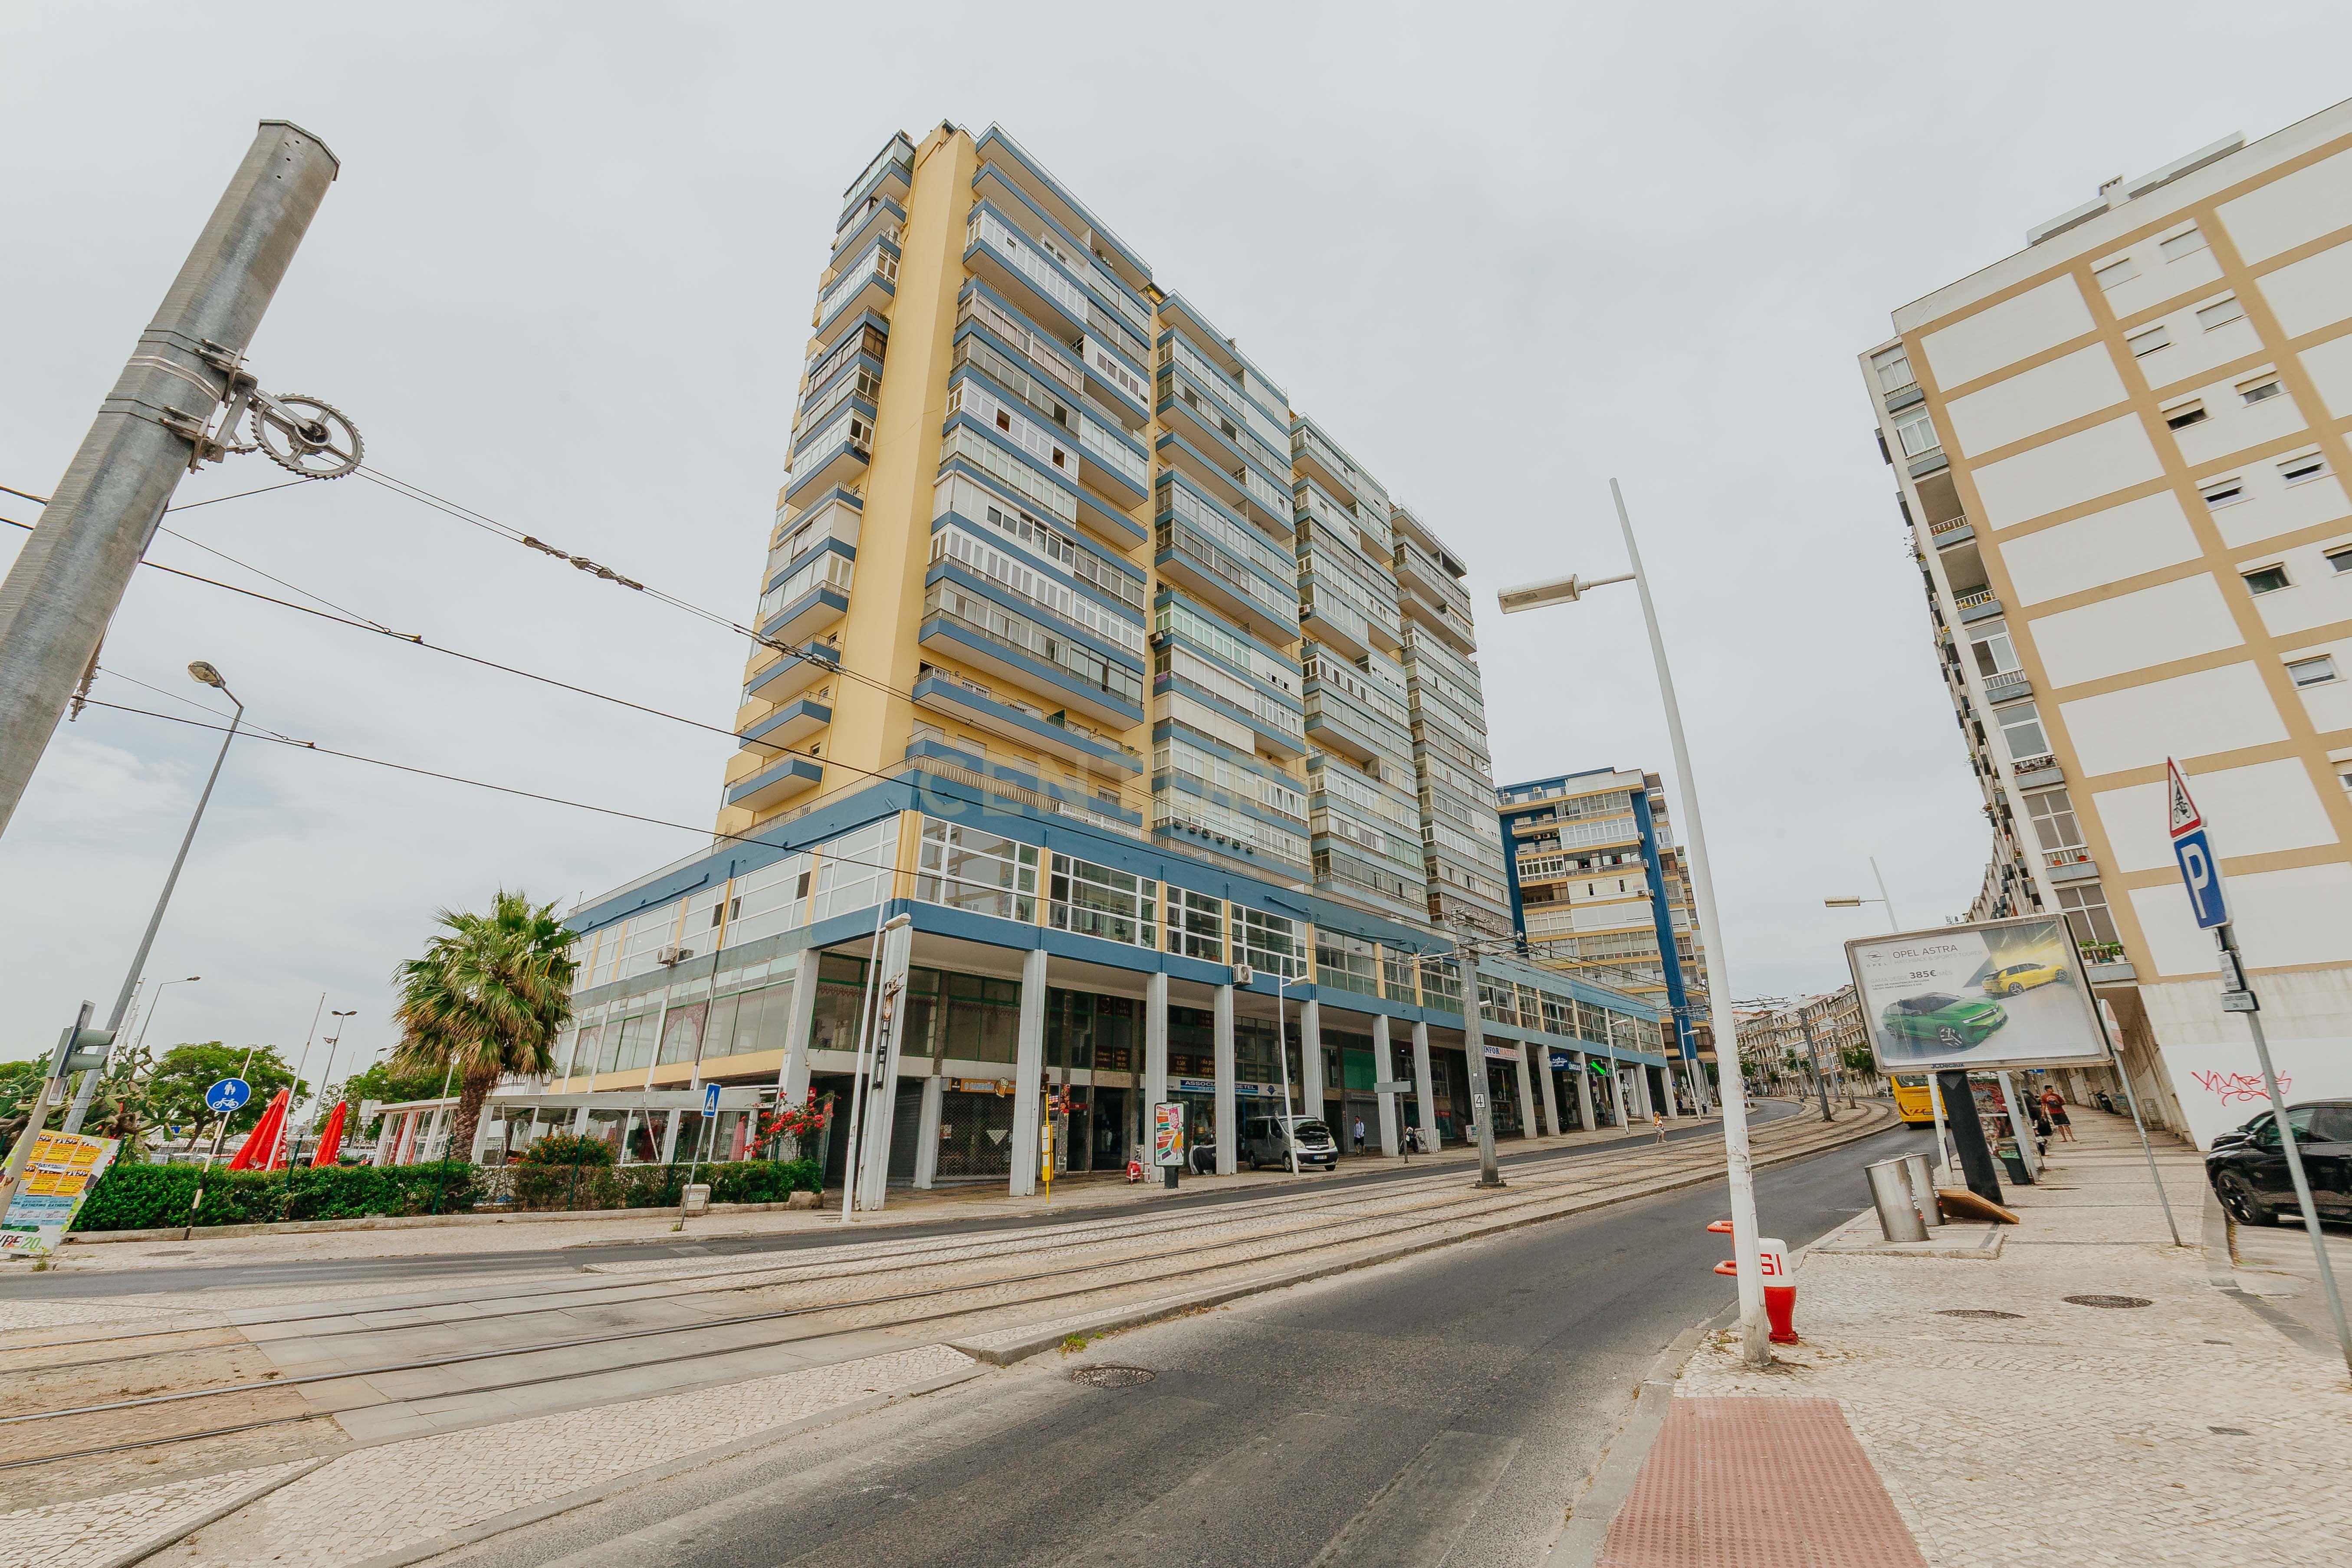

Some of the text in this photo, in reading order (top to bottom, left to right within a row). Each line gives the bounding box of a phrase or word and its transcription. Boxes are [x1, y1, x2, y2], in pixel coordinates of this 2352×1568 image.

[2181, 843, 2209, 919] P
[1893, 945, 1958, 959] OPEL ASTRA
[1475, 1095, 1483, 1106] 4
